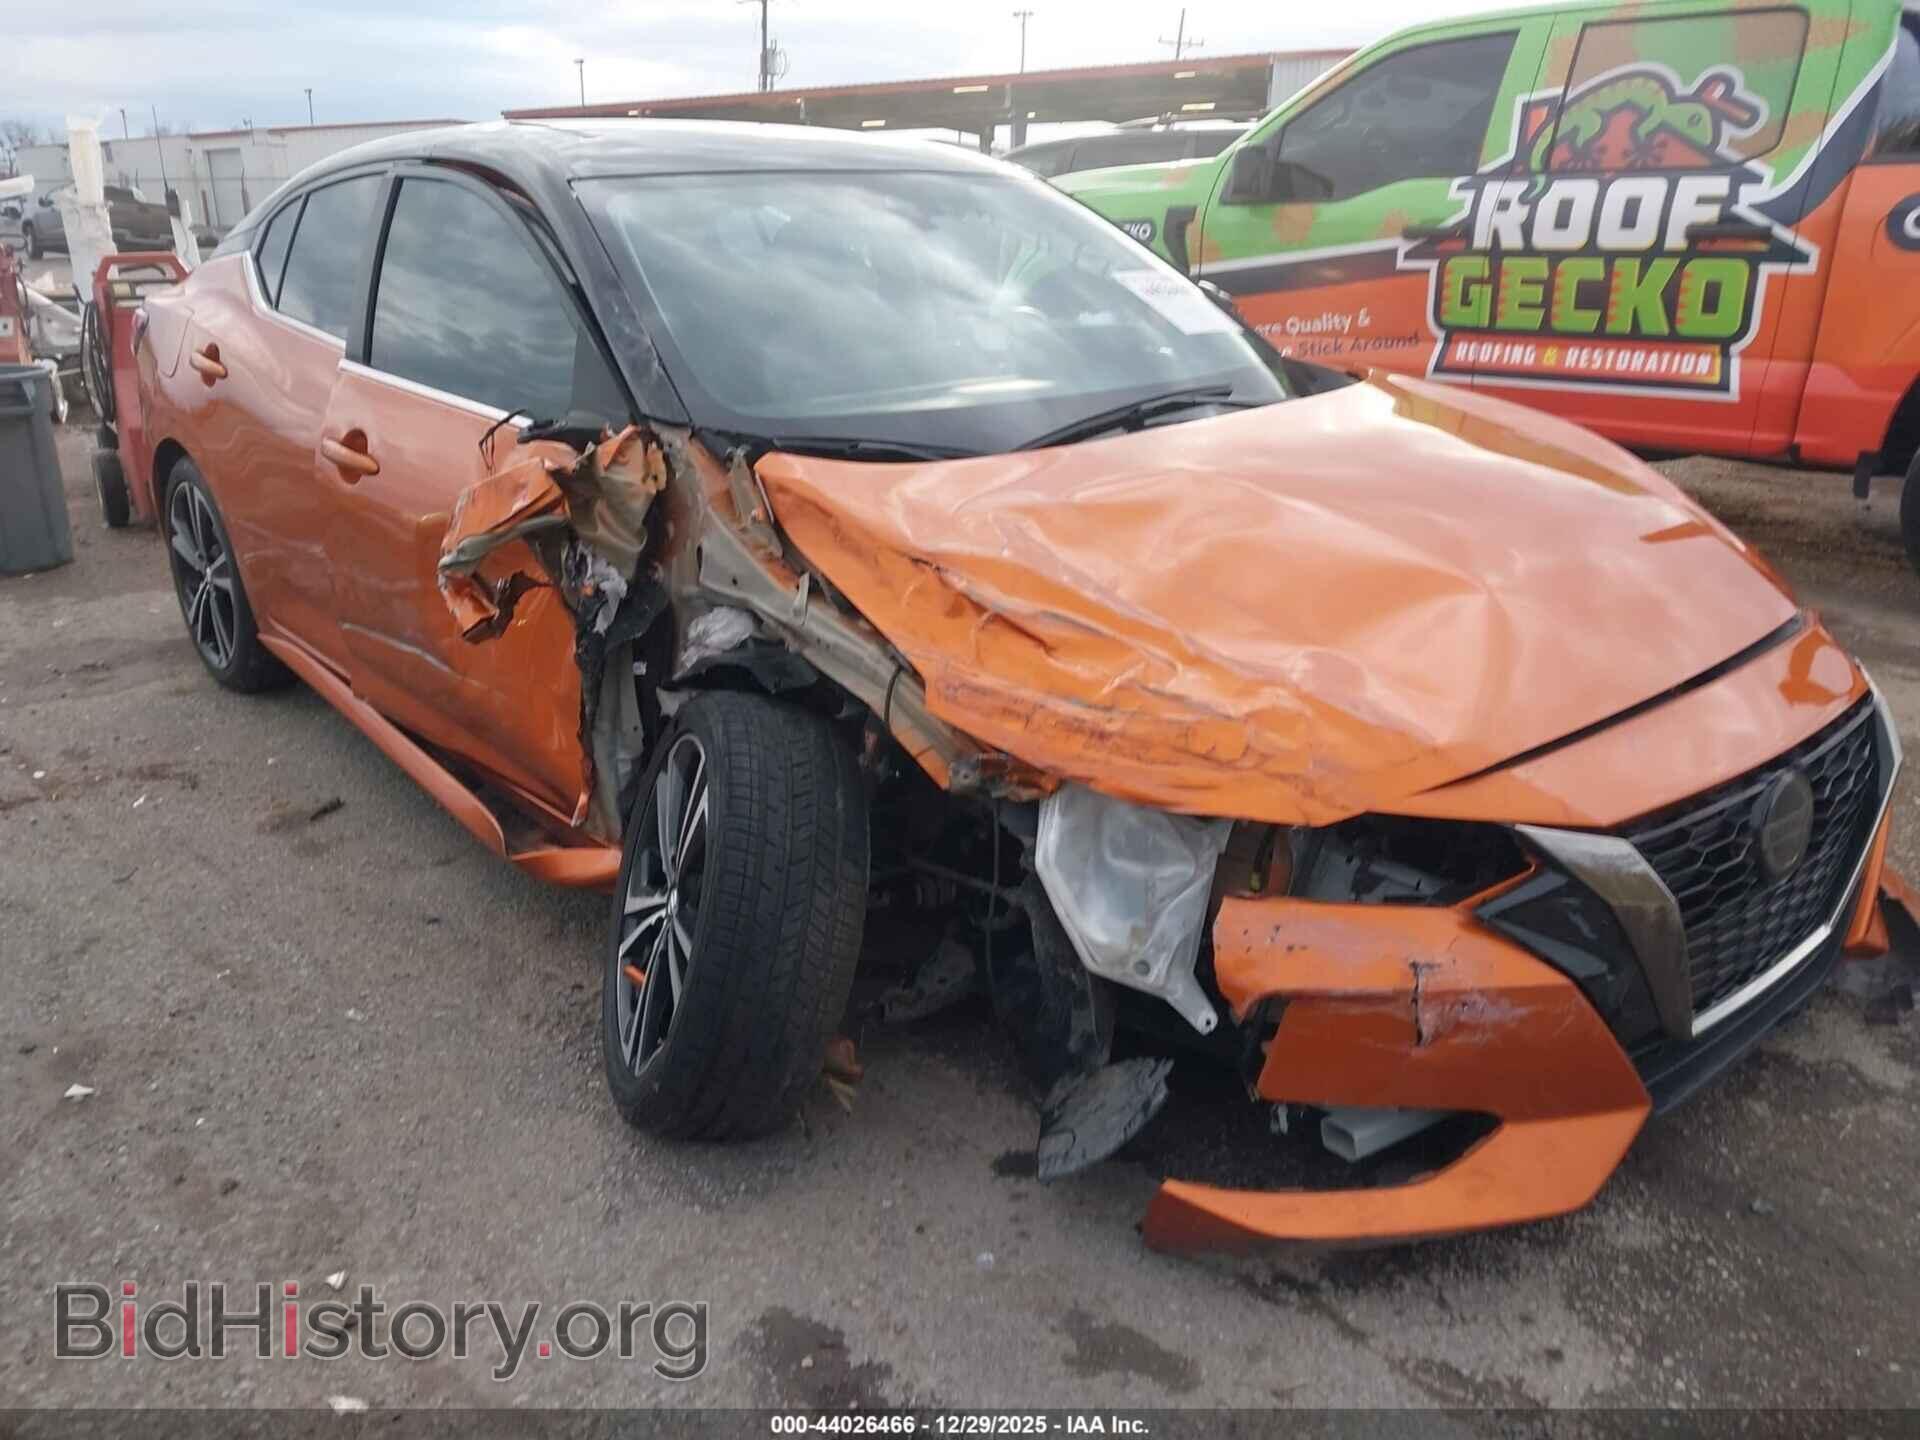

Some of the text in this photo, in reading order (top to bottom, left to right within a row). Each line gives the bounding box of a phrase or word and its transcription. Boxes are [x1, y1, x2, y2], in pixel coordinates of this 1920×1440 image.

[1472, 177, 1730, 251] ROOF
[1441, 256, 1750, 337] GECKO
[1286, 312, 1352, 335] Quality
[1358, 307, 1371, 327] &
[1299, 336, 1344, 358] Stick
[1350, 329, 1420, 352] Around
[1455, 341, 1713, 376] ROOFING & RESTORATION
